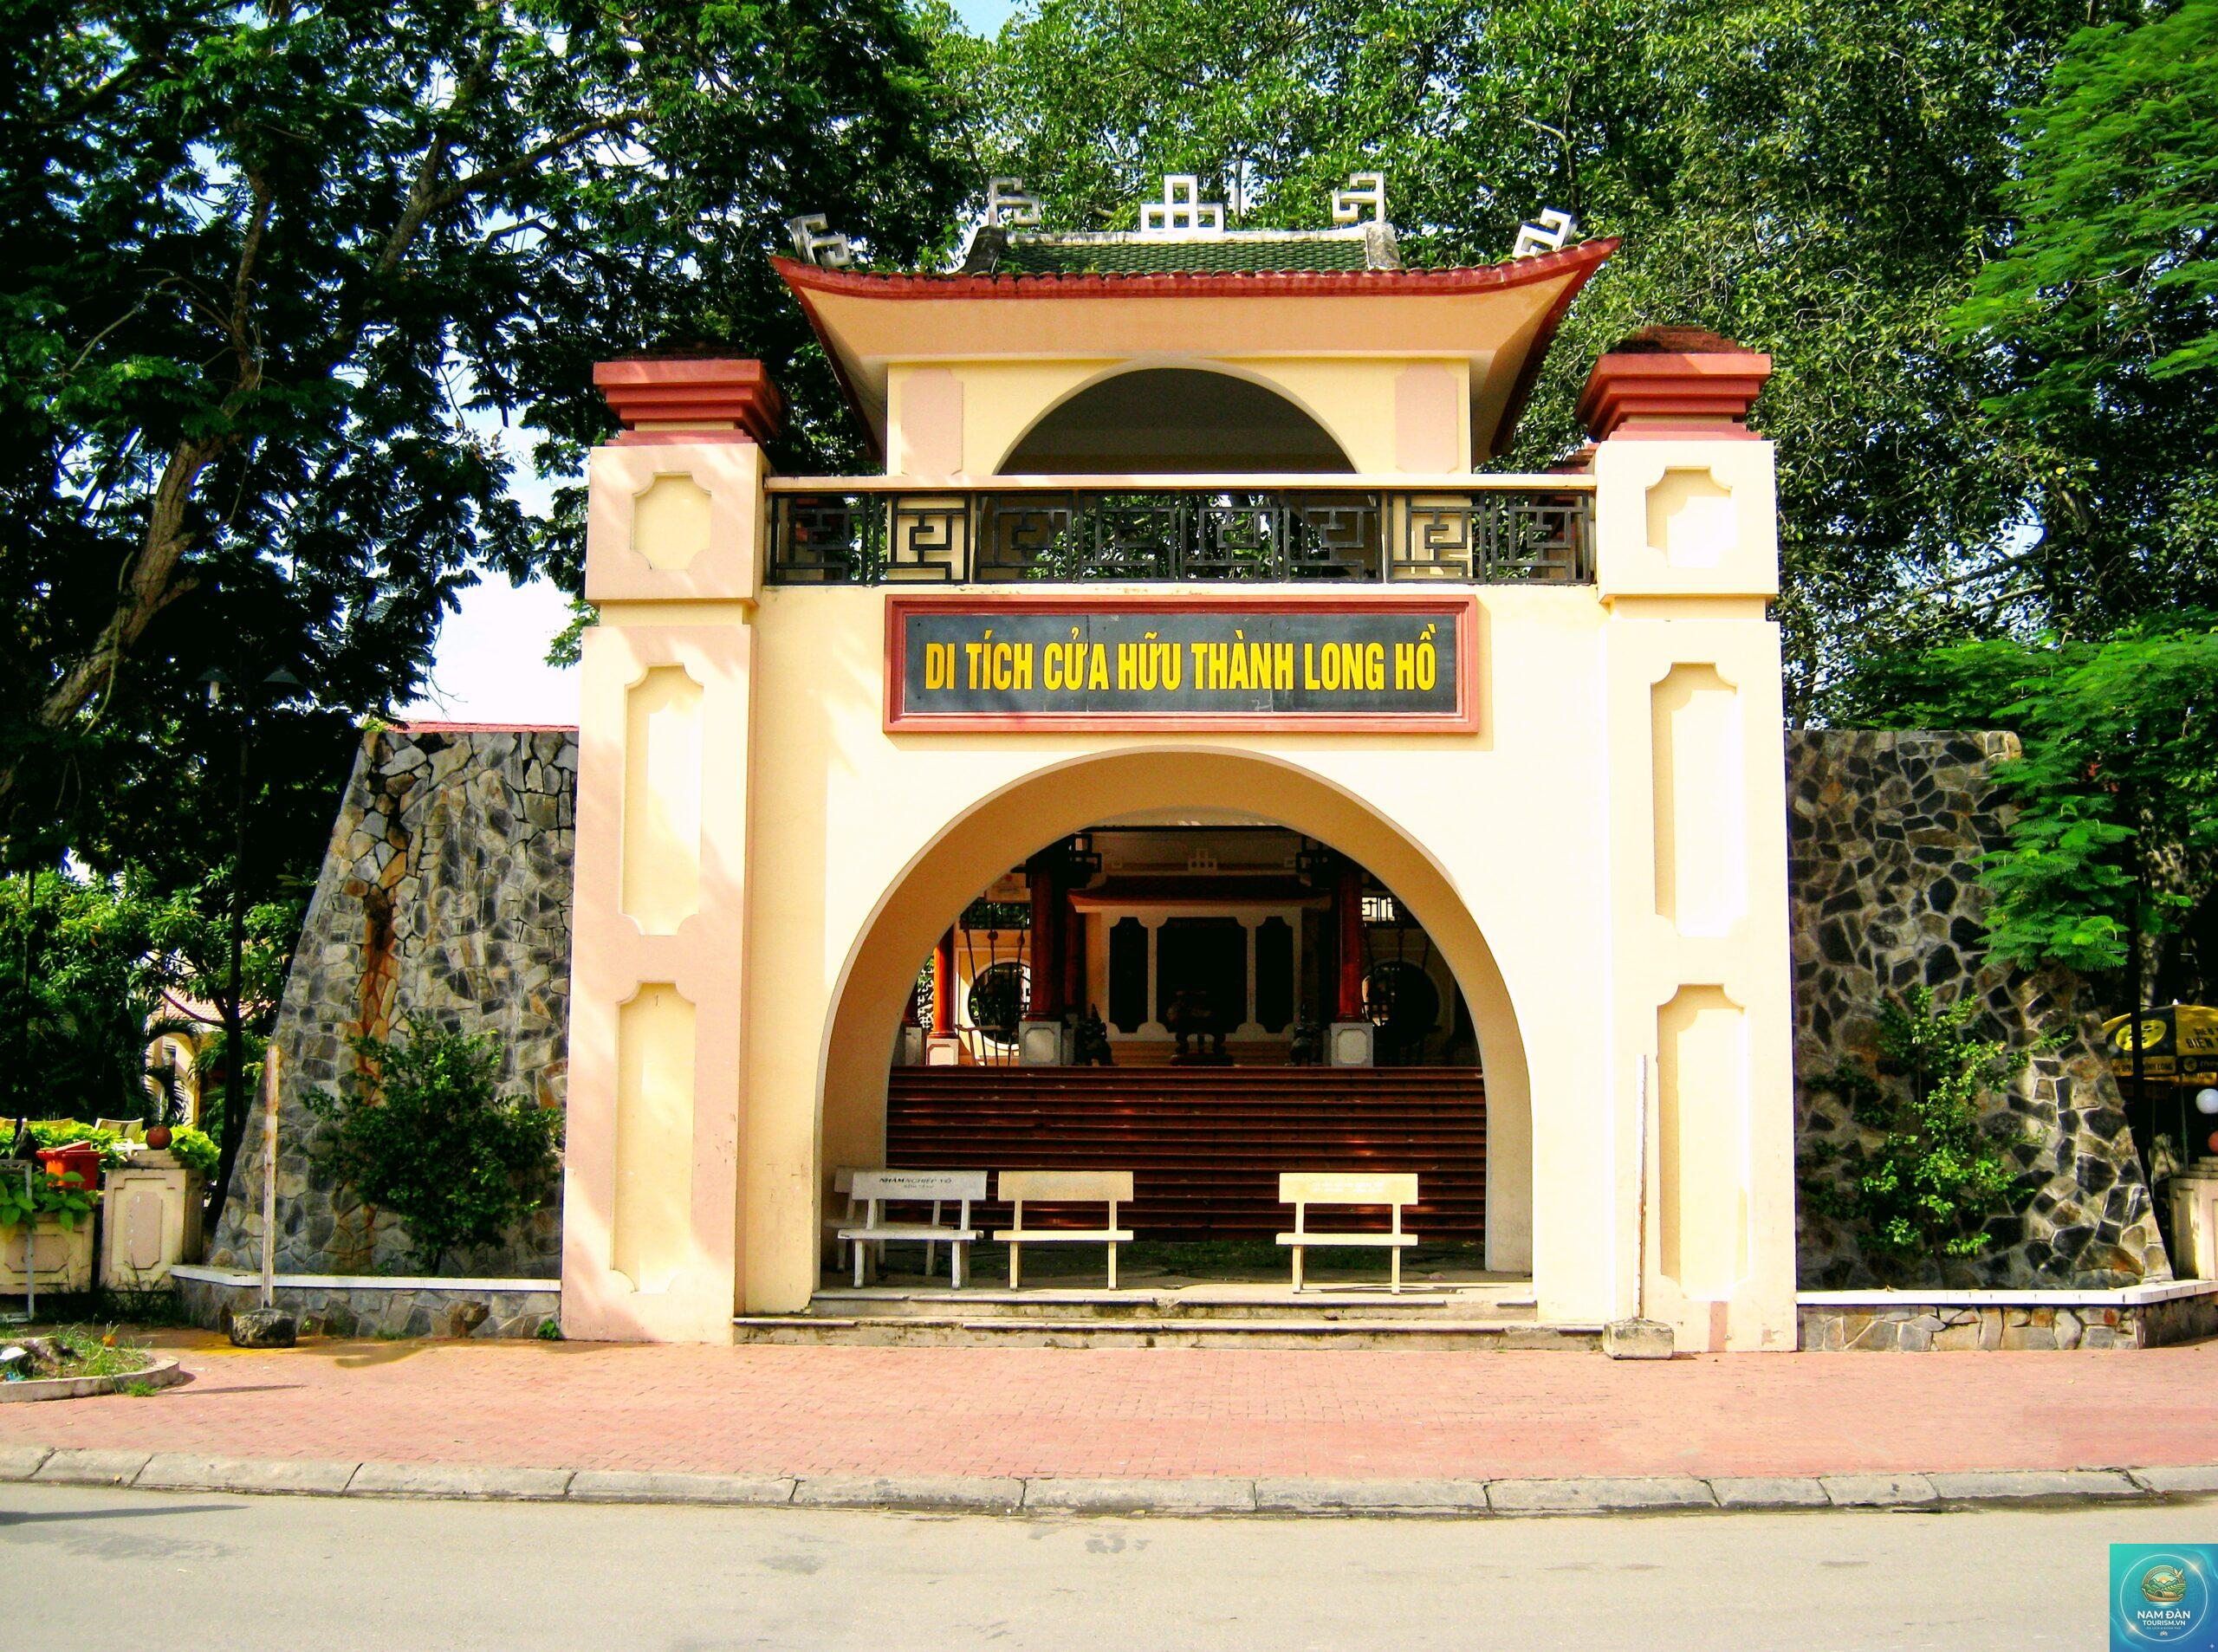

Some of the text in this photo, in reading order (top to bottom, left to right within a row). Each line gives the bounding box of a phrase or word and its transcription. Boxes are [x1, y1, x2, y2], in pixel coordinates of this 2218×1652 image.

[925, 622, 1437, 691] DI TÍCH CỬA HỮU THÀNH LONG HỒ
